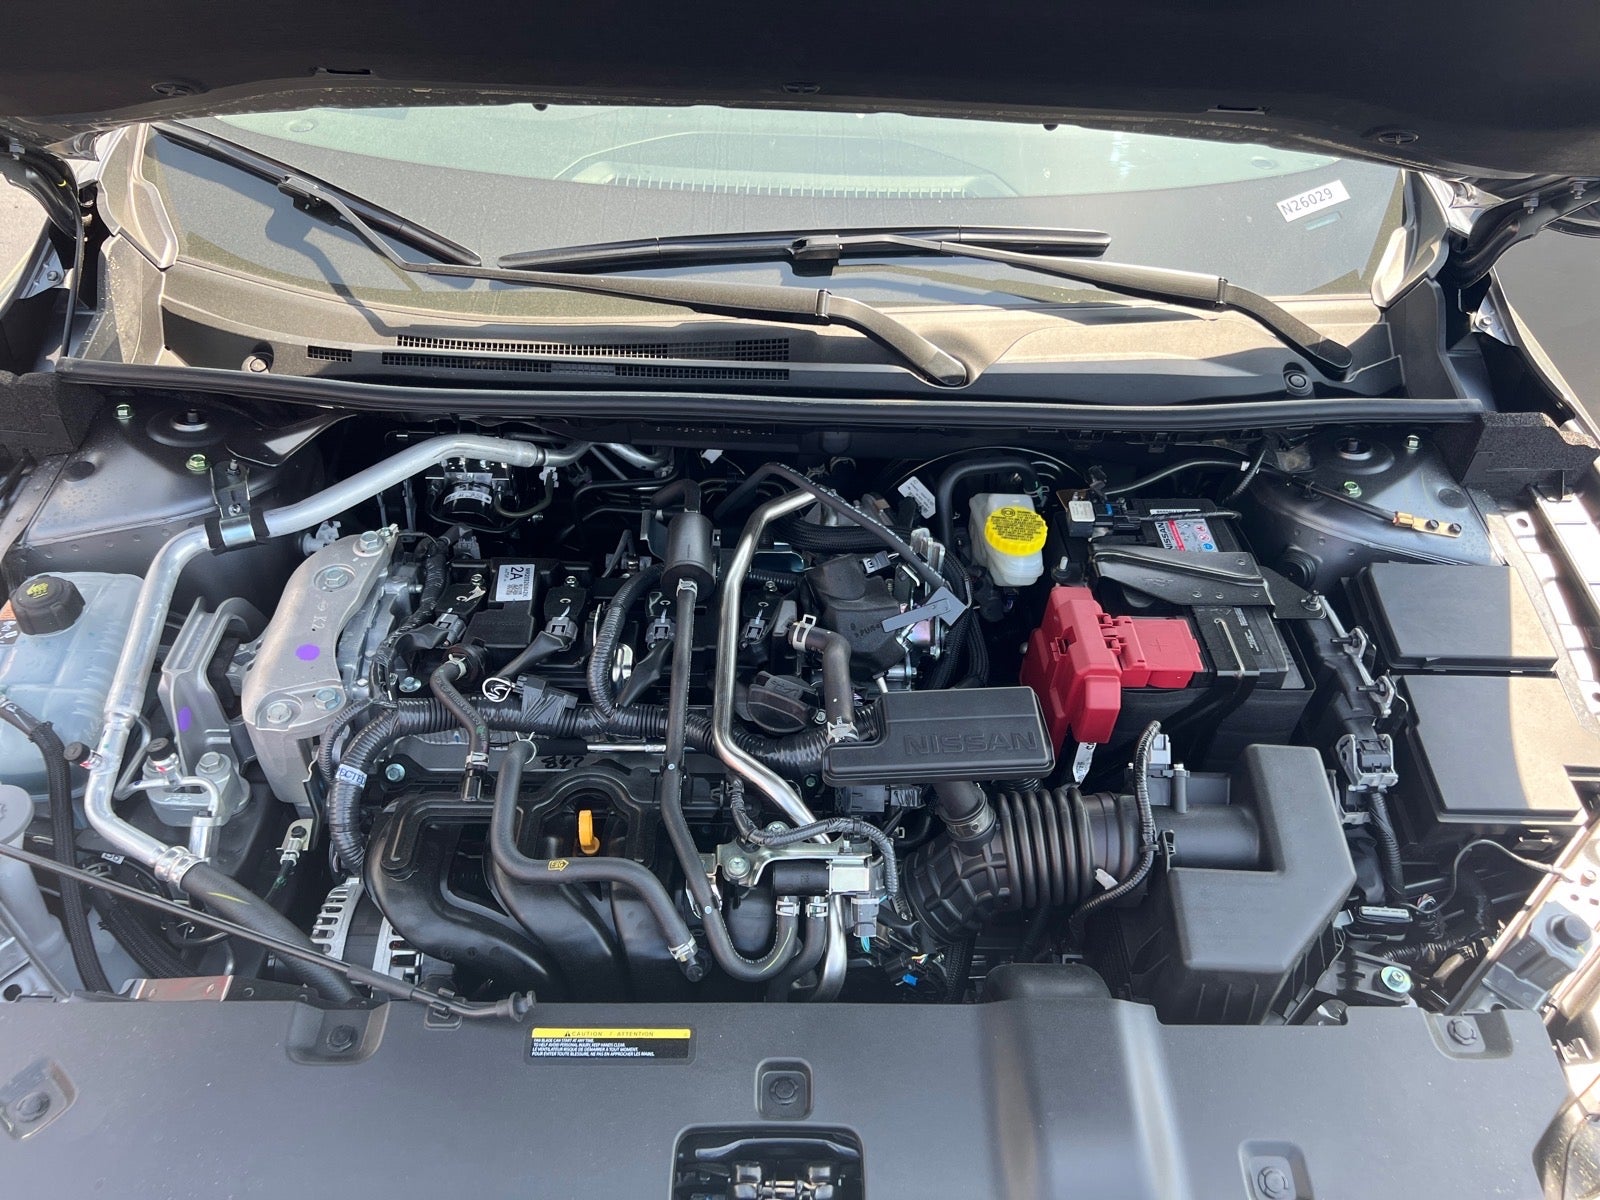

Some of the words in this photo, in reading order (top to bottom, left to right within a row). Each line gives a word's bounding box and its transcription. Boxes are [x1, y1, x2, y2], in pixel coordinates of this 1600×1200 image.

[1281, 187, 1333, 216] N26029
[510, 566, 524, 581] 2A
[904, 732, 1038, 756] NISSAN
